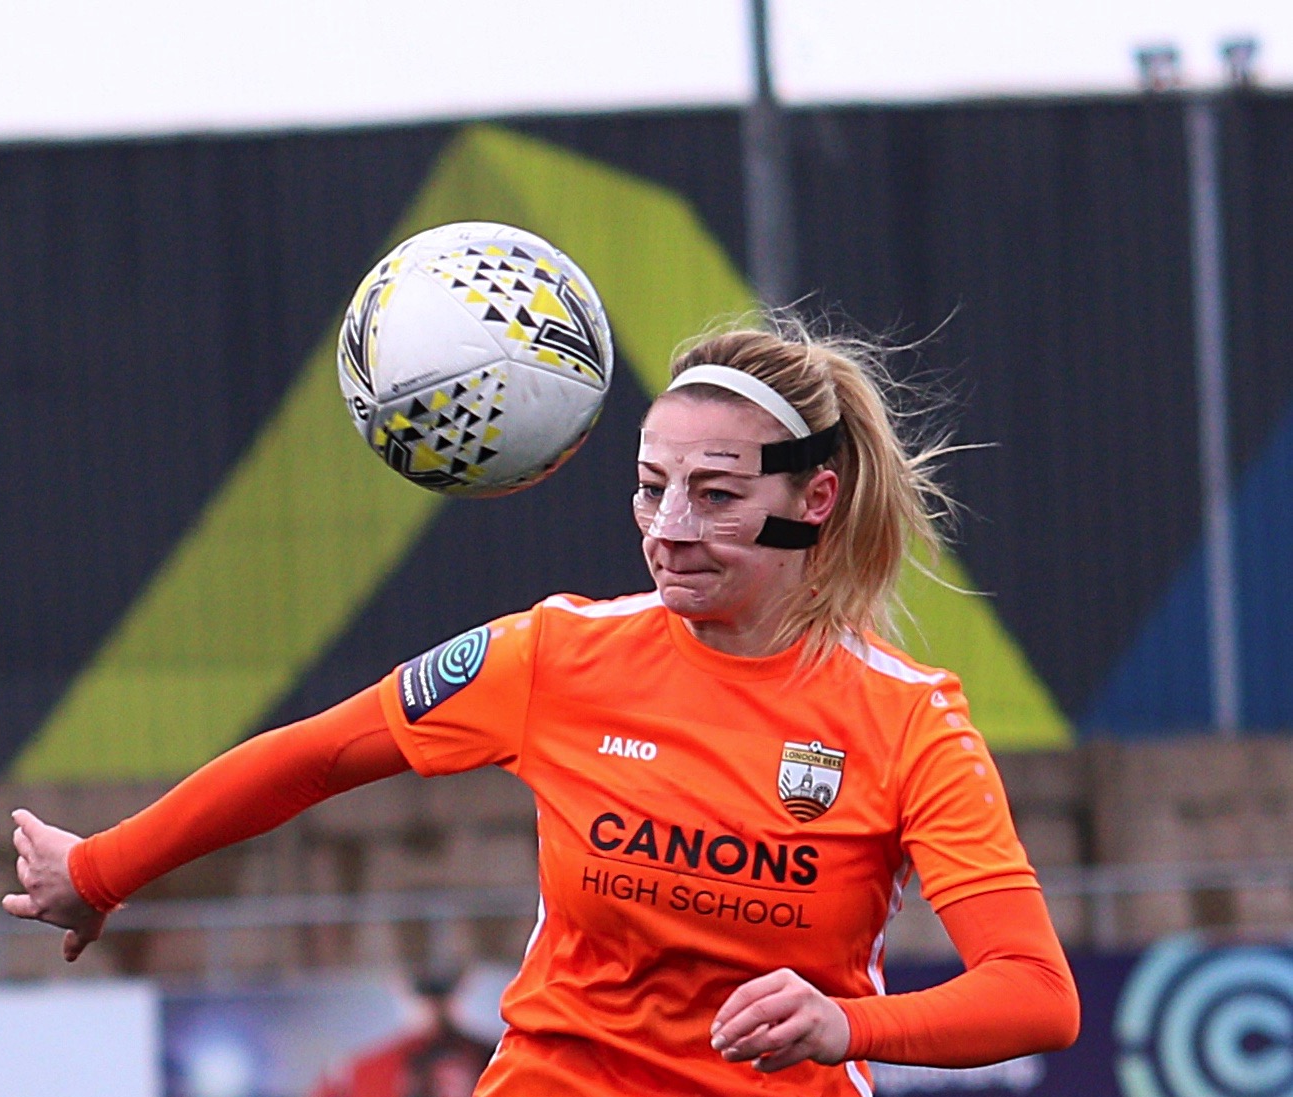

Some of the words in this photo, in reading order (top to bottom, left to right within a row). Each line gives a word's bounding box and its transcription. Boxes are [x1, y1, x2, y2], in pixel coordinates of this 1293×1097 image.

[597, 735, 658, 761] JAKO
[784, 750, 821, 764] LONDON
[589, 811, 820, 887] CANONS
[582, 866, 659, 907] HIGH
[668, 885, 813, 930] SCHOOL
